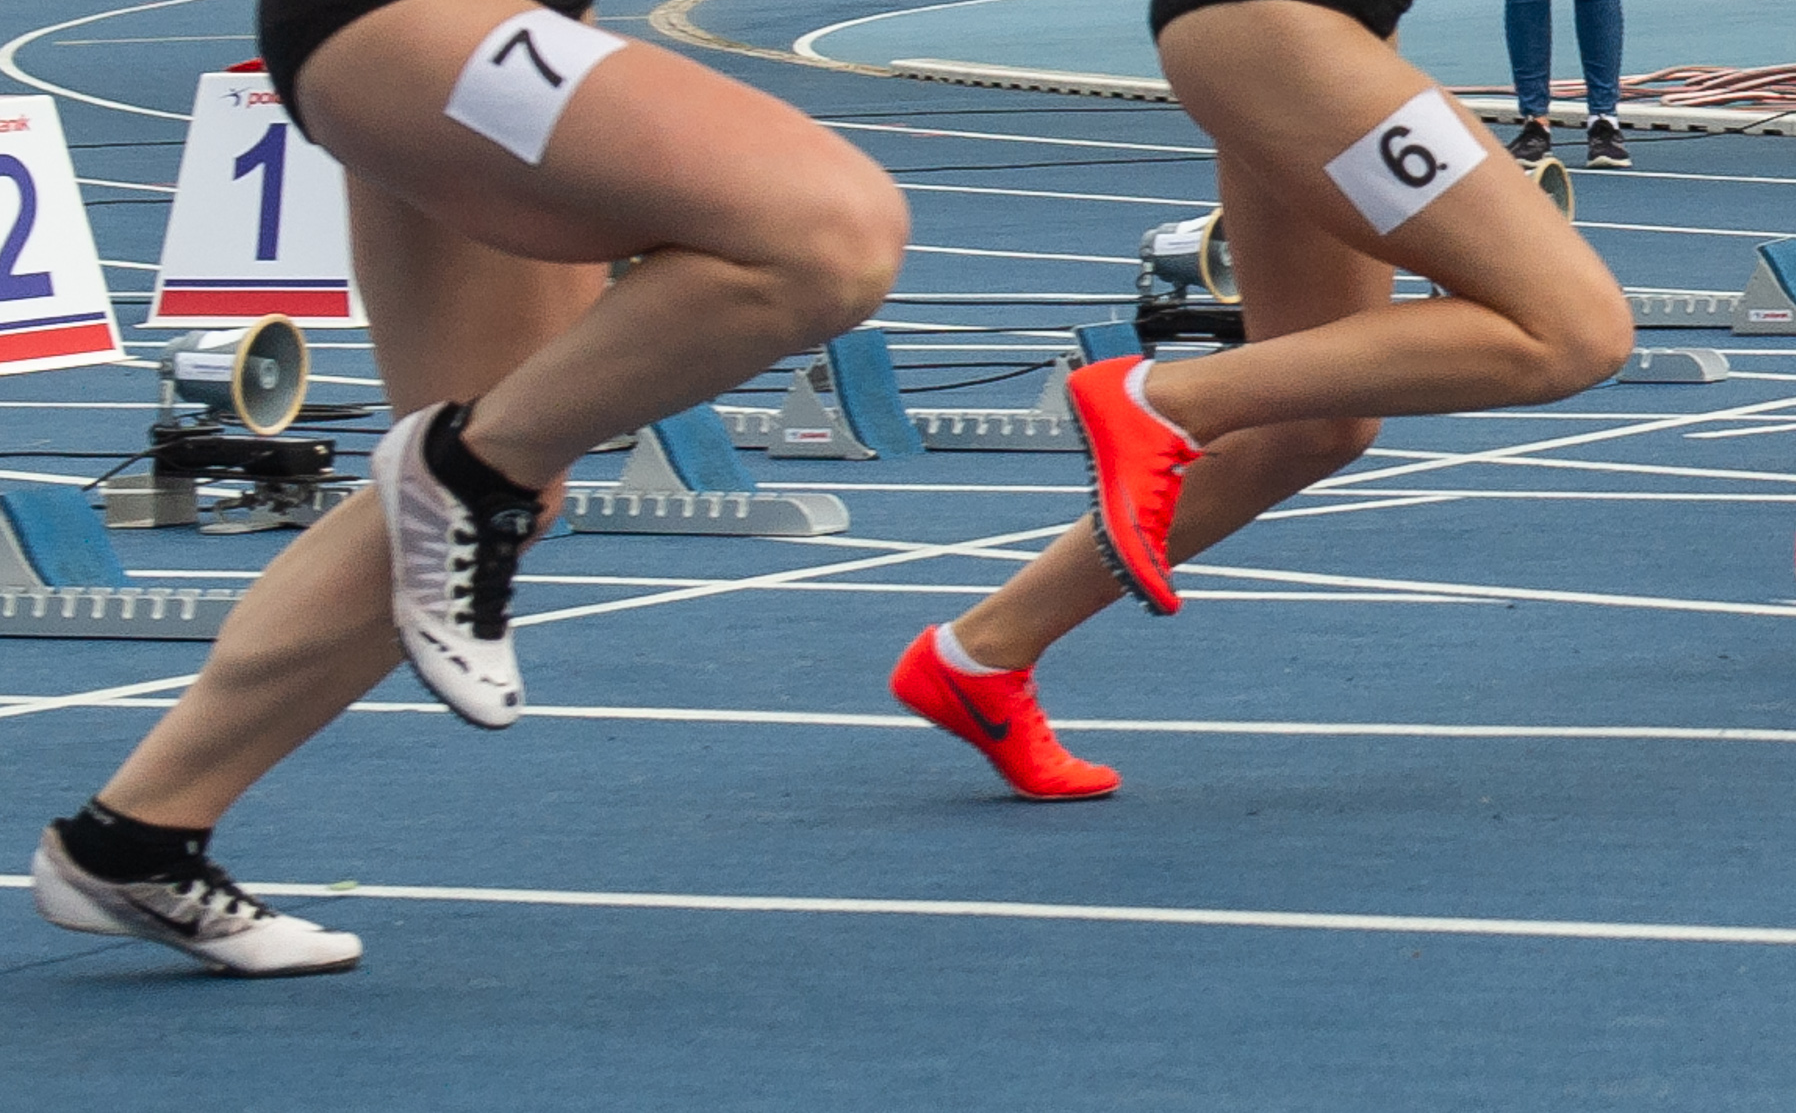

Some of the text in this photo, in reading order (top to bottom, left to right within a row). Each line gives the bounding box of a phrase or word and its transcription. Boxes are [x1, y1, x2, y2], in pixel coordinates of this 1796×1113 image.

[492, 29, 562, 88] 7
[0, 153, 54, 301] 2
[233, 122, 288, 261] 1
